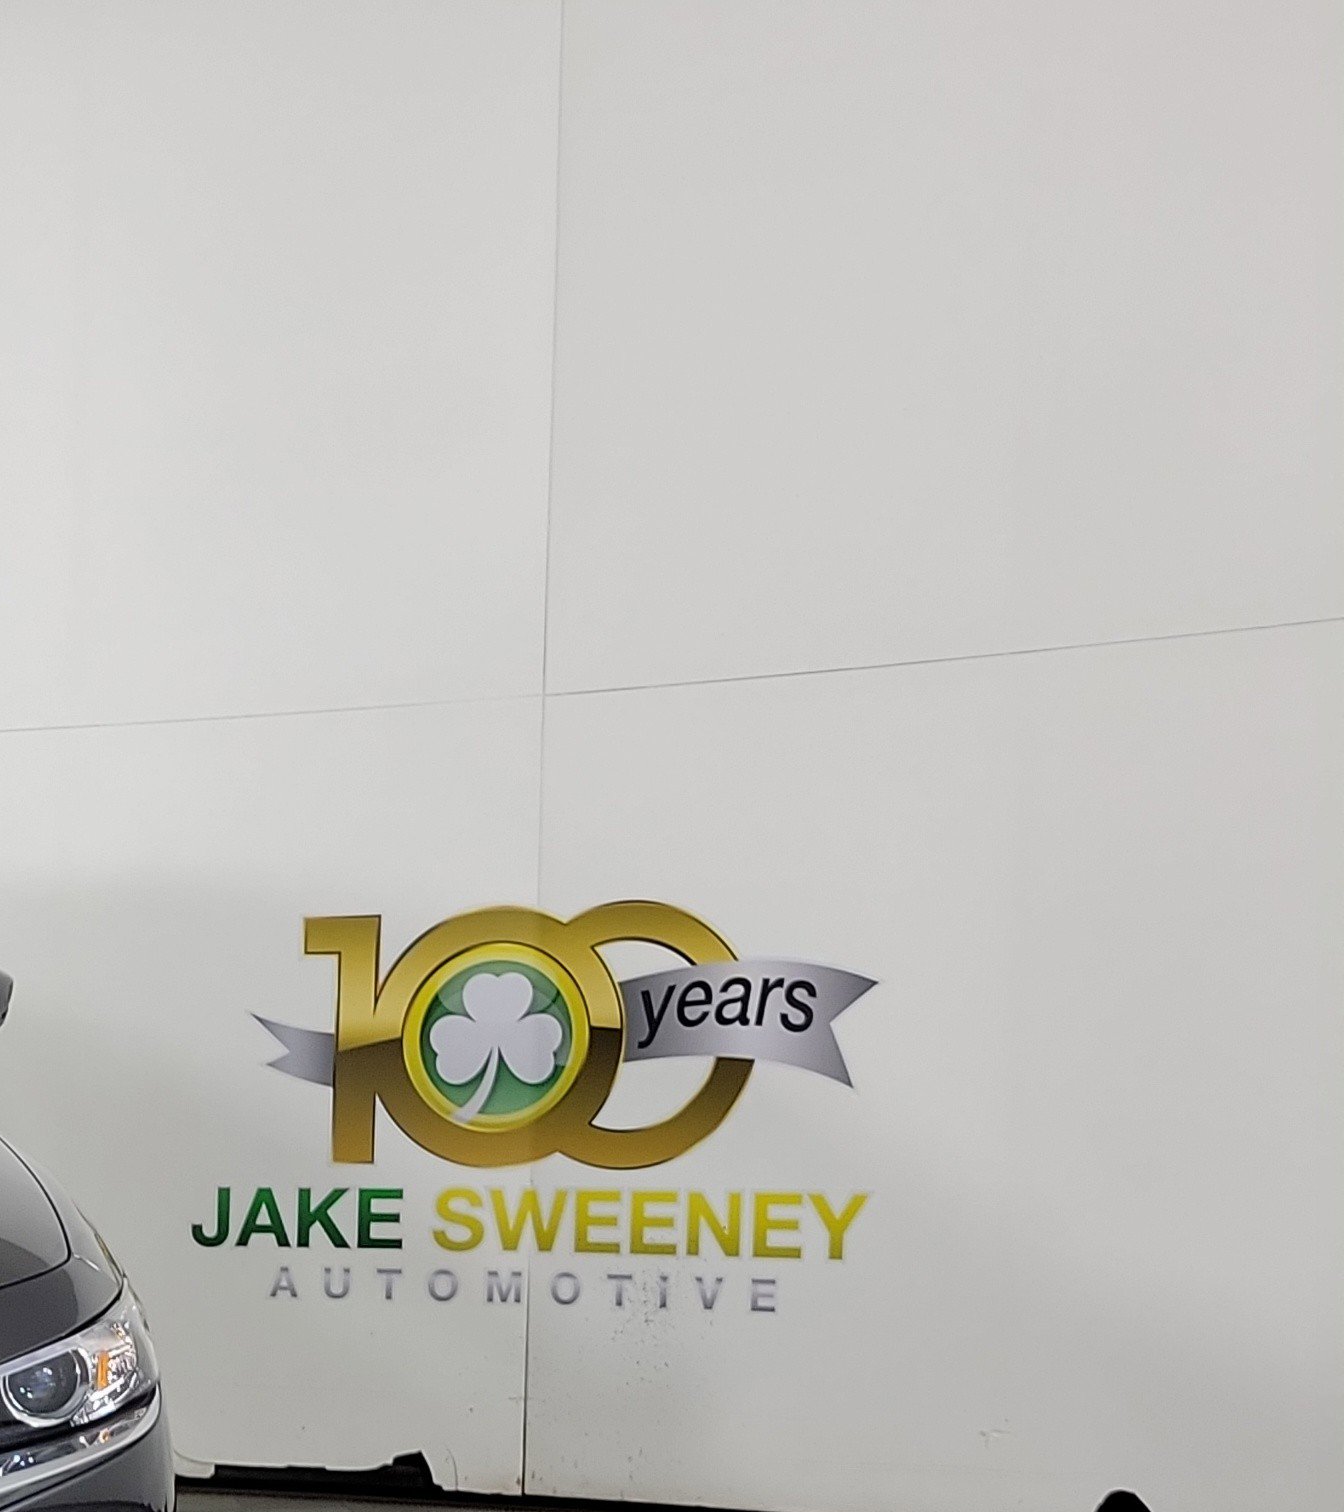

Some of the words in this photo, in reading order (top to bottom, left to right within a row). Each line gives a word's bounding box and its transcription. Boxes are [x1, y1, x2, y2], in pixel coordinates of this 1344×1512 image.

[304, 900, 755, 1169] 100
[638, 977, 817, 1048] years
[192, 1186, 405, 1250] JAKE
[431, 1187, 869, 1261] SWEENEY
[269, 1265, 777, 1313] AUTOMOTIVE
